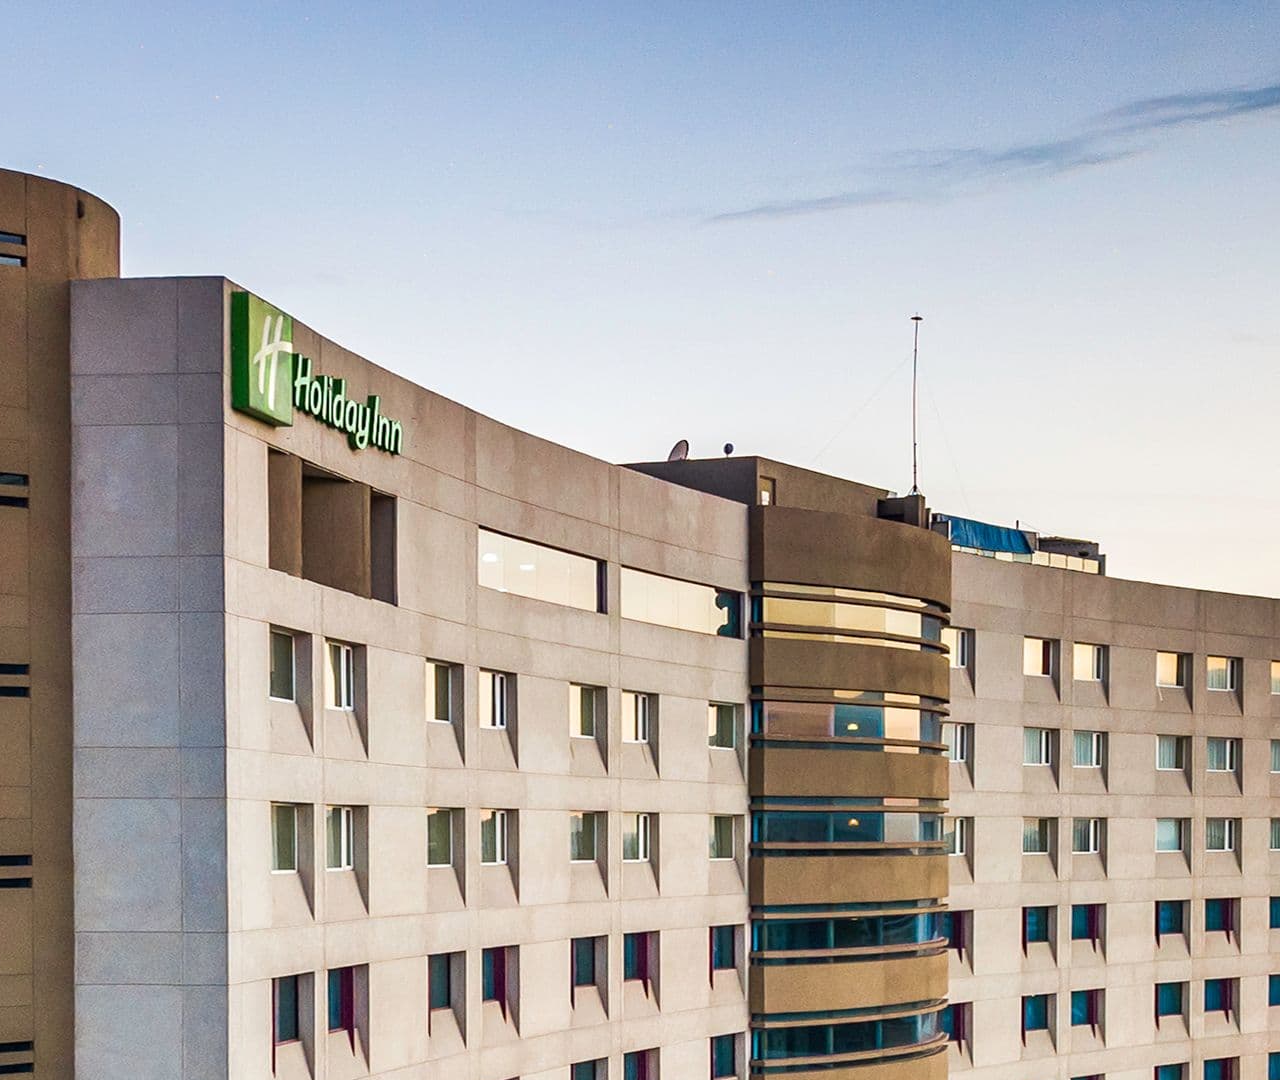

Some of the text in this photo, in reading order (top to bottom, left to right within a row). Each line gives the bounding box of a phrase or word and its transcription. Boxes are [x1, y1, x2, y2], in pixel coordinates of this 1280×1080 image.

[253, 315, 293, 411] H
[294, 353, 402, 455] Holiday Inn
